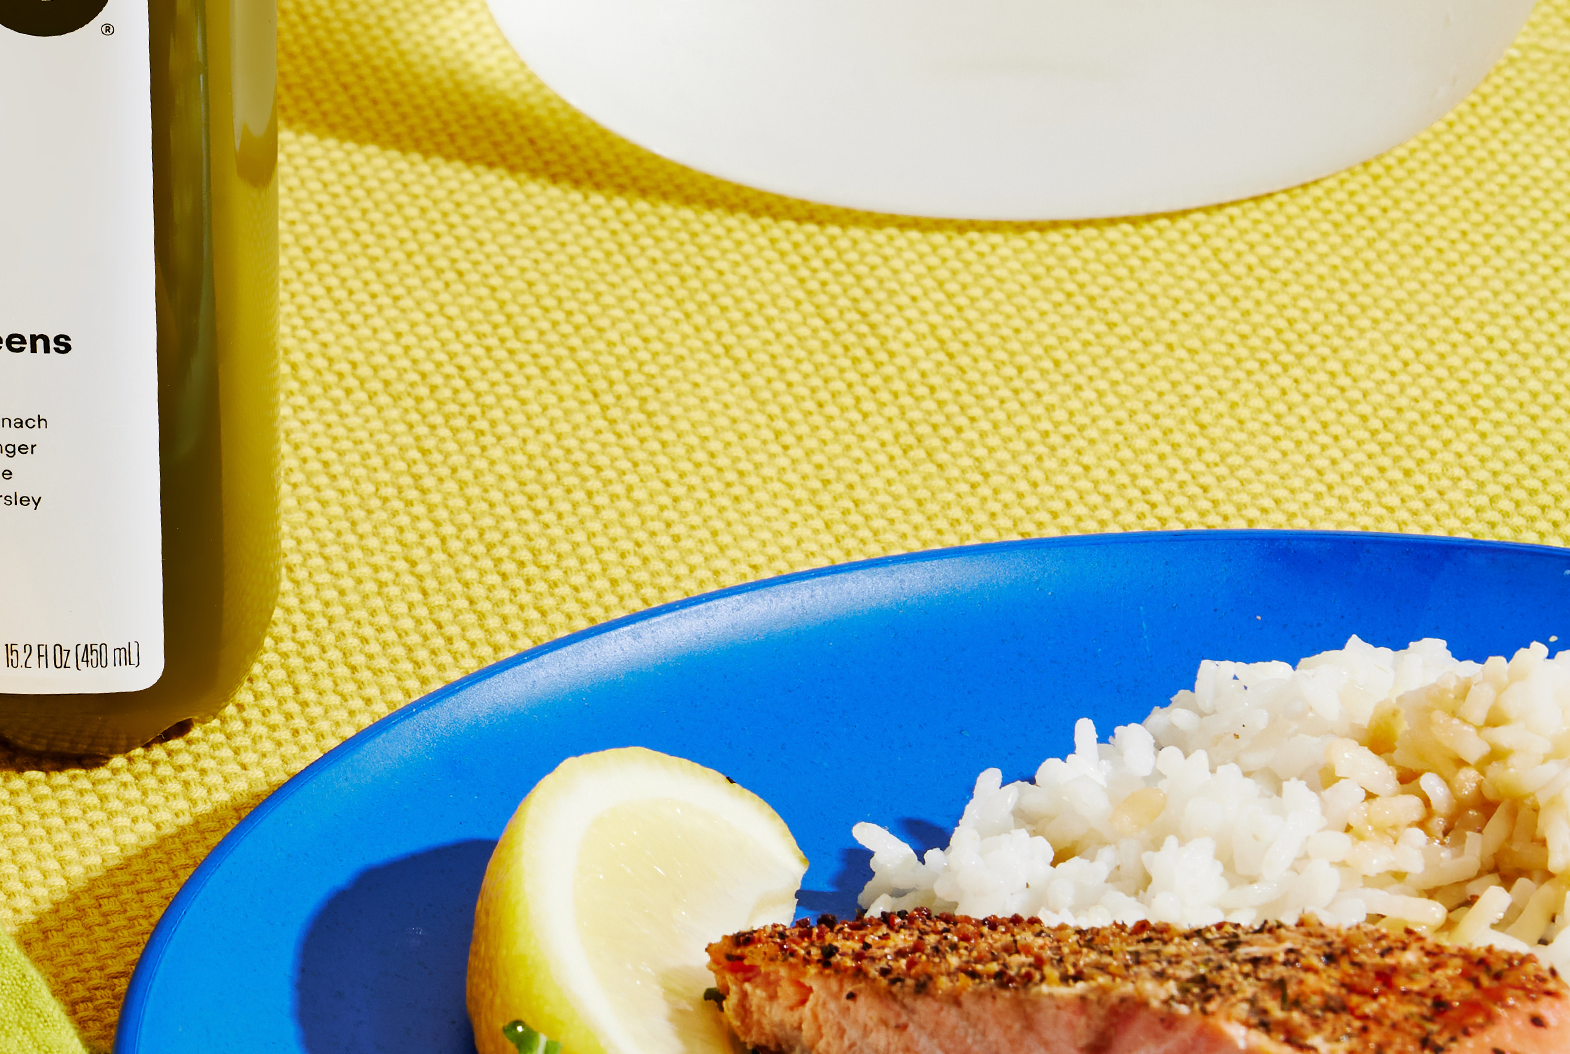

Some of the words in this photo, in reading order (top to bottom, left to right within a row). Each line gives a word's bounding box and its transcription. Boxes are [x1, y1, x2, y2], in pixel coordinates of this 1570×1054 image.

[4, 643, 33, 669] 15.2
[37, 644, 49, 669] Fl
[53, 643, 71, 669] Oz
[74, 642, 108, 671] (450
[113, 640, 140, 668] mL)
